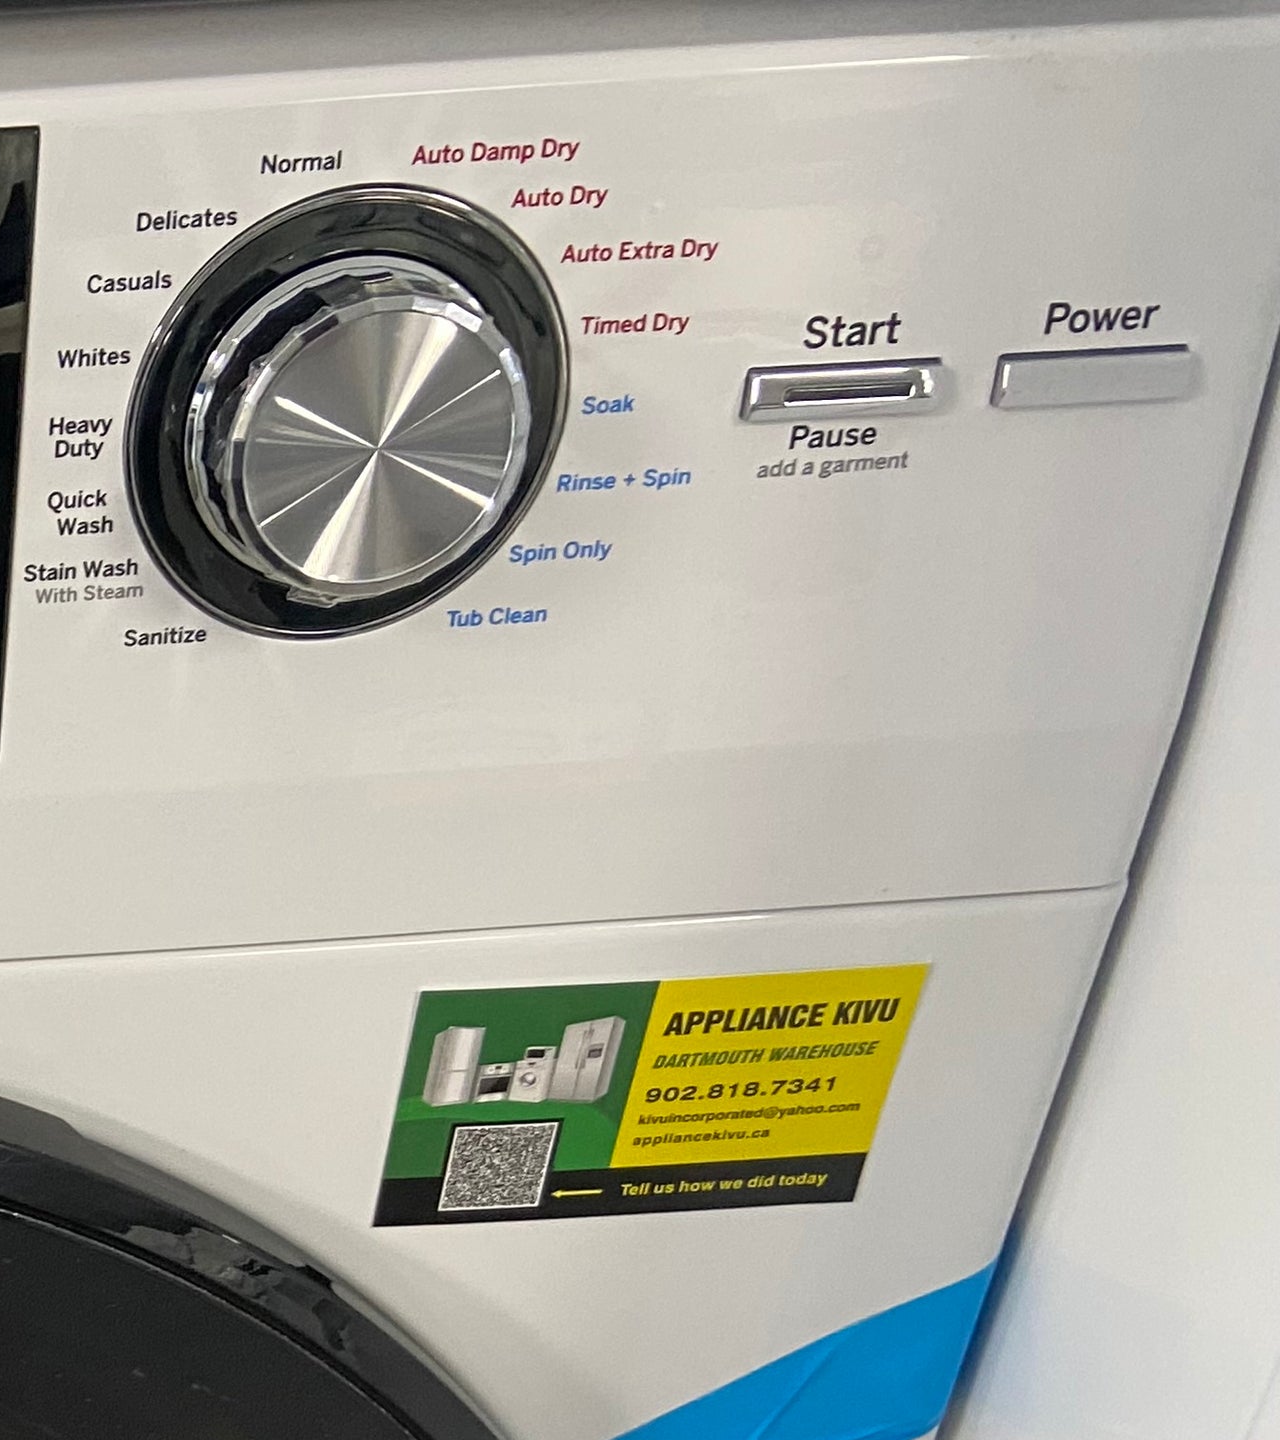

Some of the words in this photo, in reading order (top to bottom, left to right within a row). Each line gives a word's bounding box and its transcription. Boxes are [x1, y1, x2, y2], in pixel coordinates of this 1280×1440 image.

[260, 150, 342, 174] Normal
[412, 144, 464, 165] Auto
[470, 139, 535, 164] Damp
[540, 137, 580, 162] Dry
[510, 188, 564, 208] Auto
[569, 185, 609, 208] Dry
[136, 208, 238, 232] Delicates
[560, 244, 612, 263] Auto
[618, 241, 674, 260] Extra
[680, 238, 719, 261] Dry
[87, 270, 172, 294] Casuals
[580, 314, 646, 335] Timed
[652, 313, 690, 334] Dry
[802, 312, 902, 349] Start
[1043, 302, 1161, 335] Power
[57, 348, 131, 368] Whites
[581, 394, 634, 415] Soak
[48, 417, 113, 436] Heavy
[788, 424, 878, 450] Pause
[54, 439, 104, 460] Duty
[756, 461, 797, 479] add
[801, 463, 814, 477] a
[818, 450, 909, 480] garment
[556, 473, 616, 493] Rinse
[642, 468, 691, 490] Spin
[47, 489, 107, 514] Quick
[57, 515, 113, 536] Wash
[509, 543, 556, 566] Spin
[563, 539, 613, 561] Only
[23, 562, 76, 582] Stain
[83, 557, 138, 578] Wash
[35, 586, 77, 604] With
[83, 583, 143, 602] Steam
[447, 609, 483, 627] Tub
[488, 606, 548, 625] Clean
[123, 625, 207, 647] Sanitize
[662, 1003, 829, 1037] APPLIANCE
[832, 998, 901, 1026] KIVU
[651, 1048, 766, 1070] DARTMOUTH
[768, 1040, 880, 1063] WAREHOUSE
[645, 1076, 838, 1104] 902.818.7341
[638, 1102, 861, 1126] kivuincorporated@yahoo.com
[632, 1128, 771, 1147] appliancekivu.ca
[620, 1181, 650, 1196] Tell
[653, 1182, 676, 1195] us
[679, 1178, 716, 1193] how
[719, 1178, 743, 1190] we
[747, 1172, 775, 1189] did
[778, 1171, 829, 1189] today
